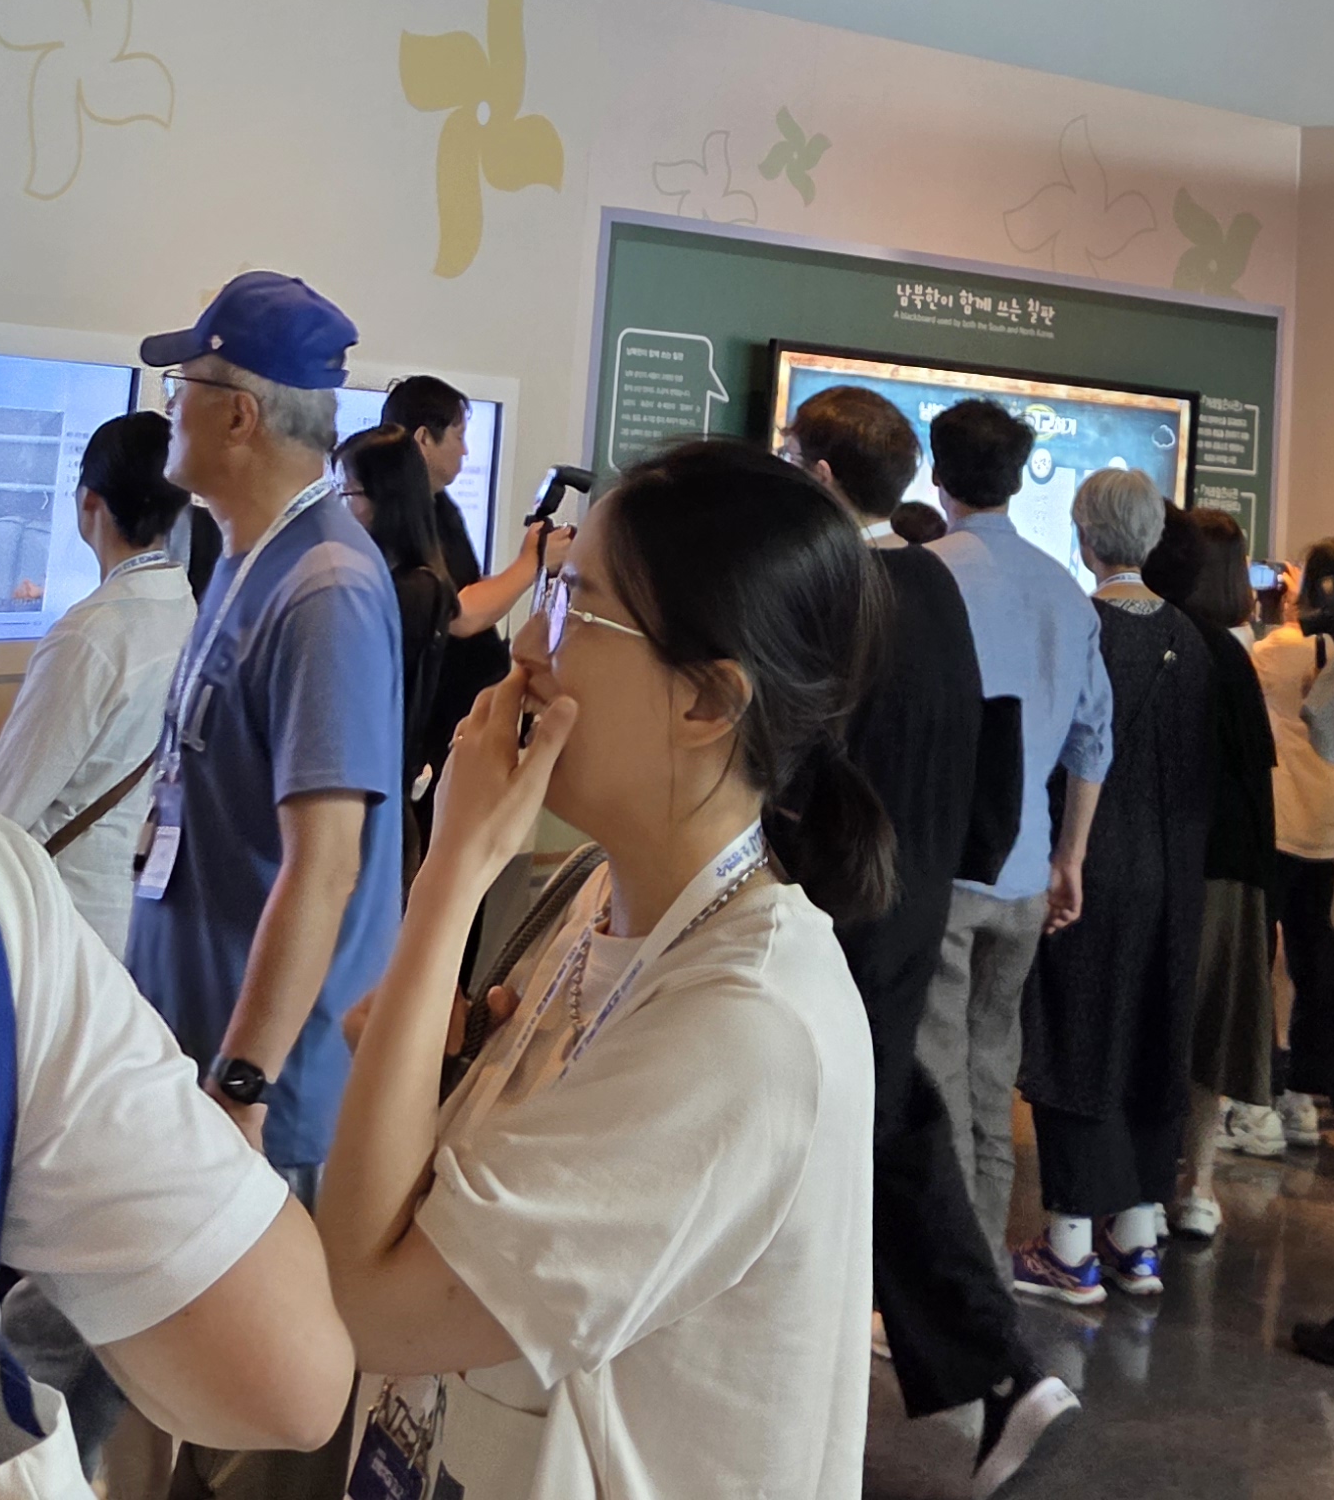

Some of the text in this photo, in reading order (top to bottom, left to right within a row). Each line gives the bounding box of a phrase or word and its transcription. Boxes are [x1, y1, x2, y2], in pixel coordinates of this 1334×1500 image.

[896, 283, 1056, 326] 남북한이 함께 쓰는 칠판
